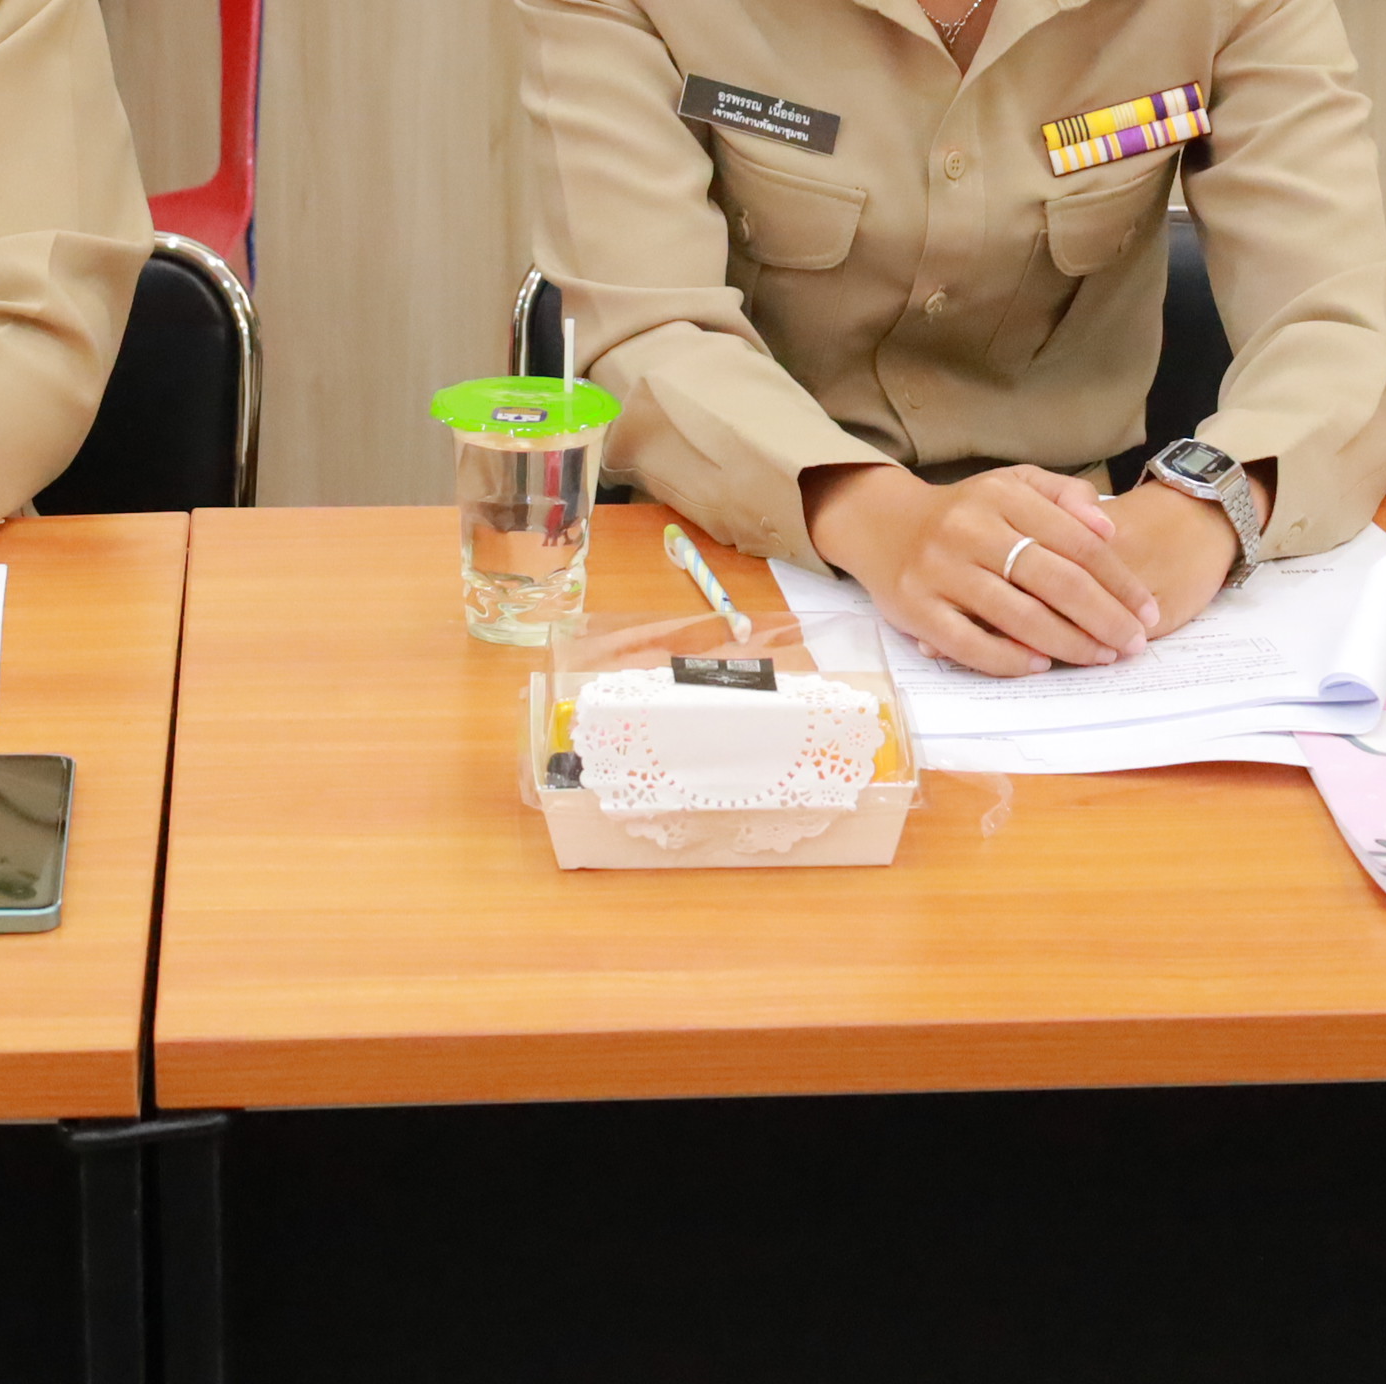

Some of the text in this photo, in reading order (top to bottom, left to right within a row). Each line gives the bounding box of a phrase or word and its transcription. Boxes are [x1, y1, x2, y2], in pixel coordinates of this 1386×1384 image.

[712, 104, 809, 142] เจ้าพนักงานพัฒนาชุมชน
[718, 91, 811, 125] อรพรรณ เนื้ออ่อน
